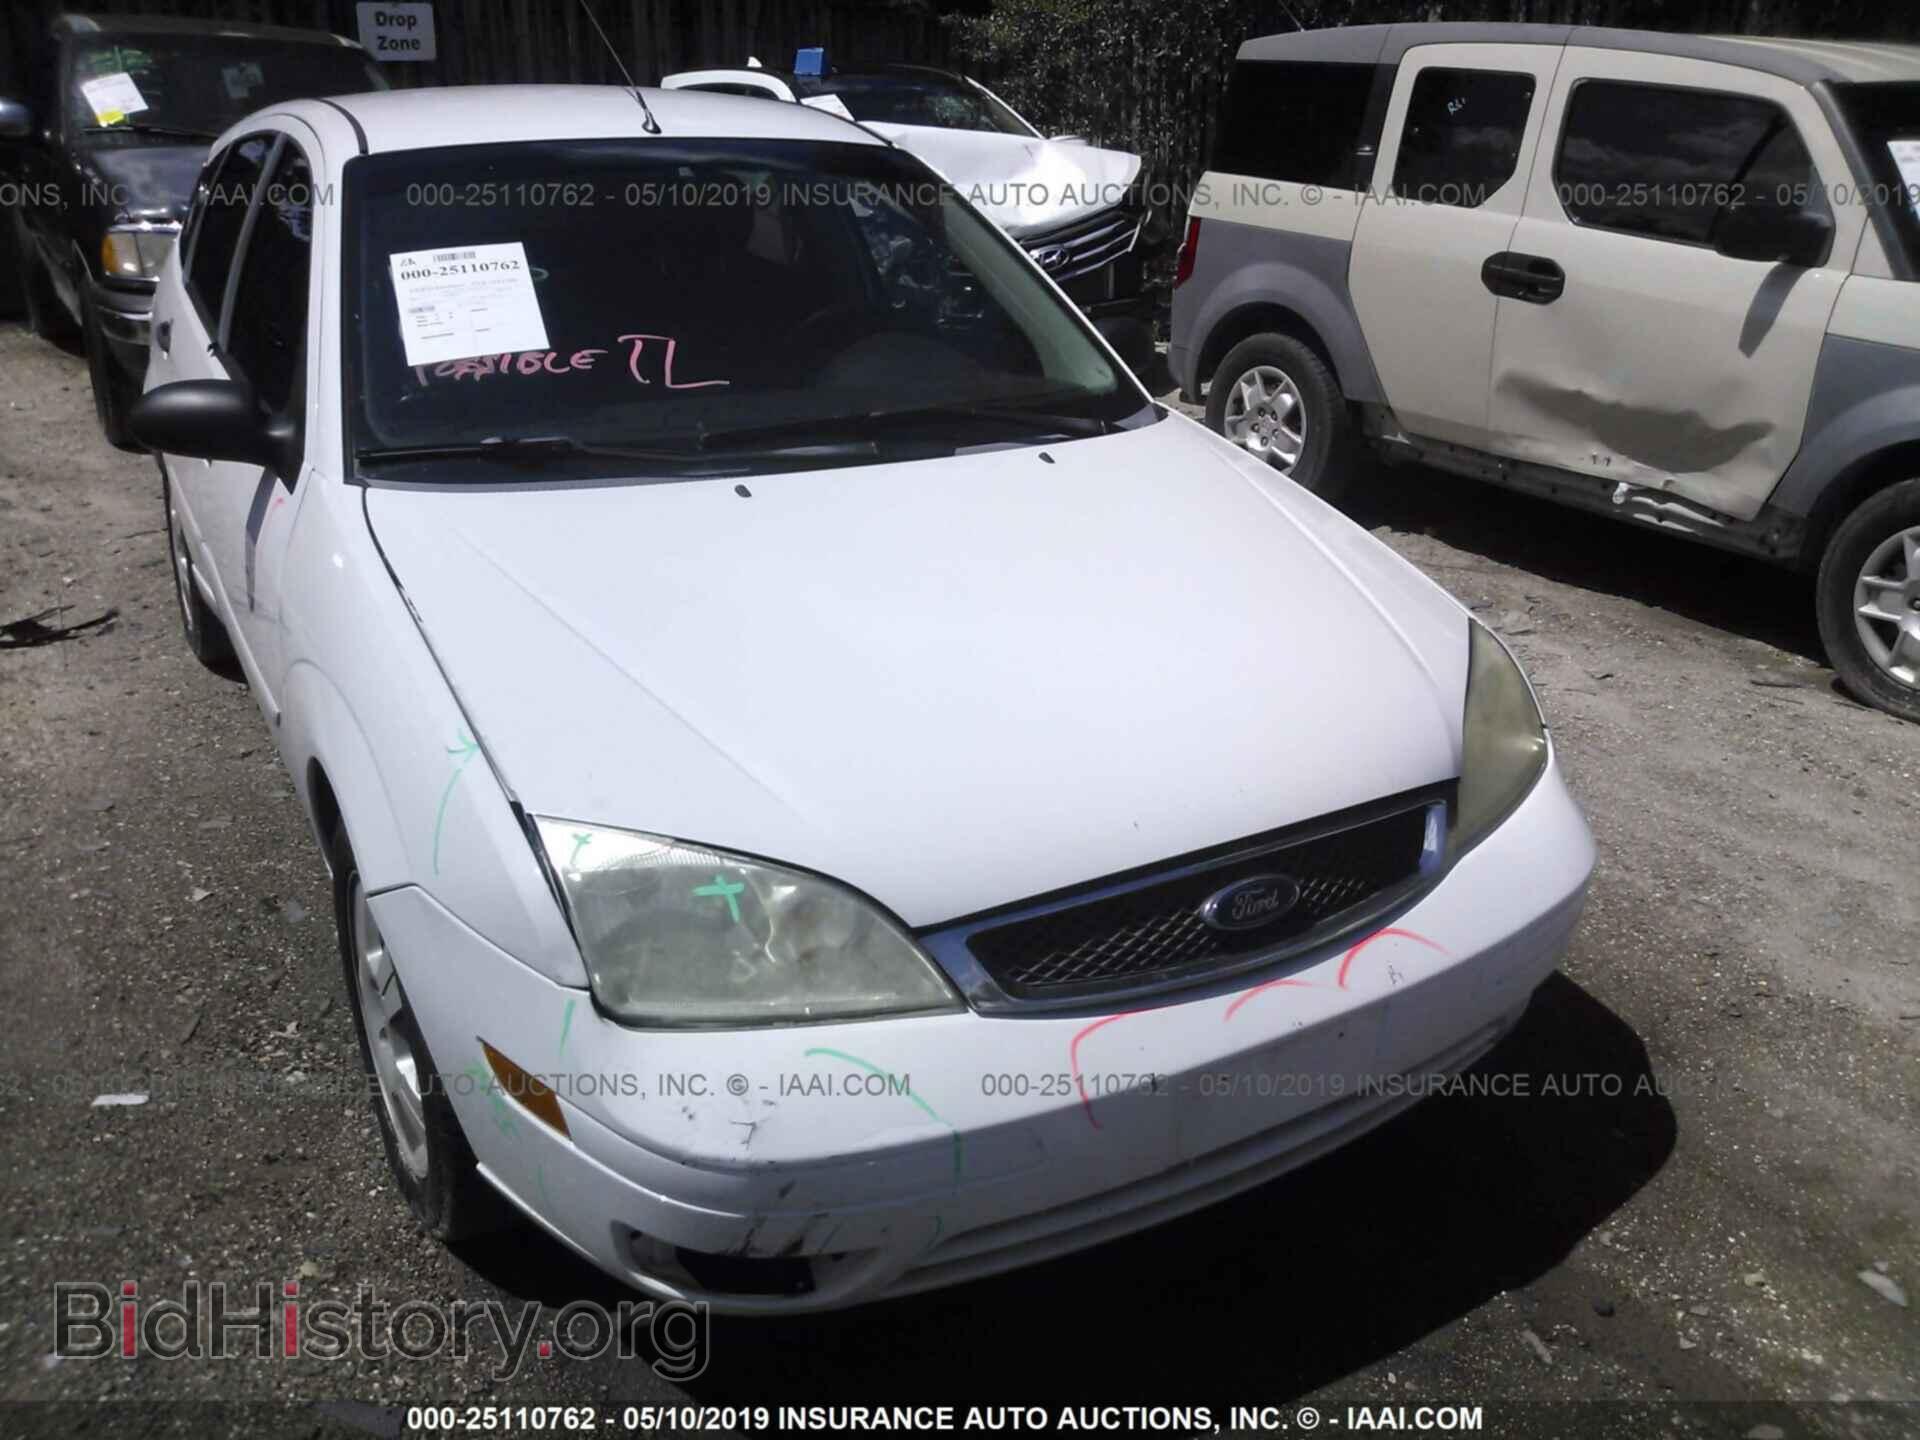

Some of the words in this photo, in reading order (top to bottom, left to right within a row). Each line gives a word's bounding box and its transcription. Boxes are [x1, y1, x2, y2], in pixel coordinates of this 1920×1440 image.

[376, 11, 417, 32] Drop
[377, 35, 420, 51] Zone
[400, 259, 521, 281] 000-25110762
[1231, 888, 1280, 920] Ford
